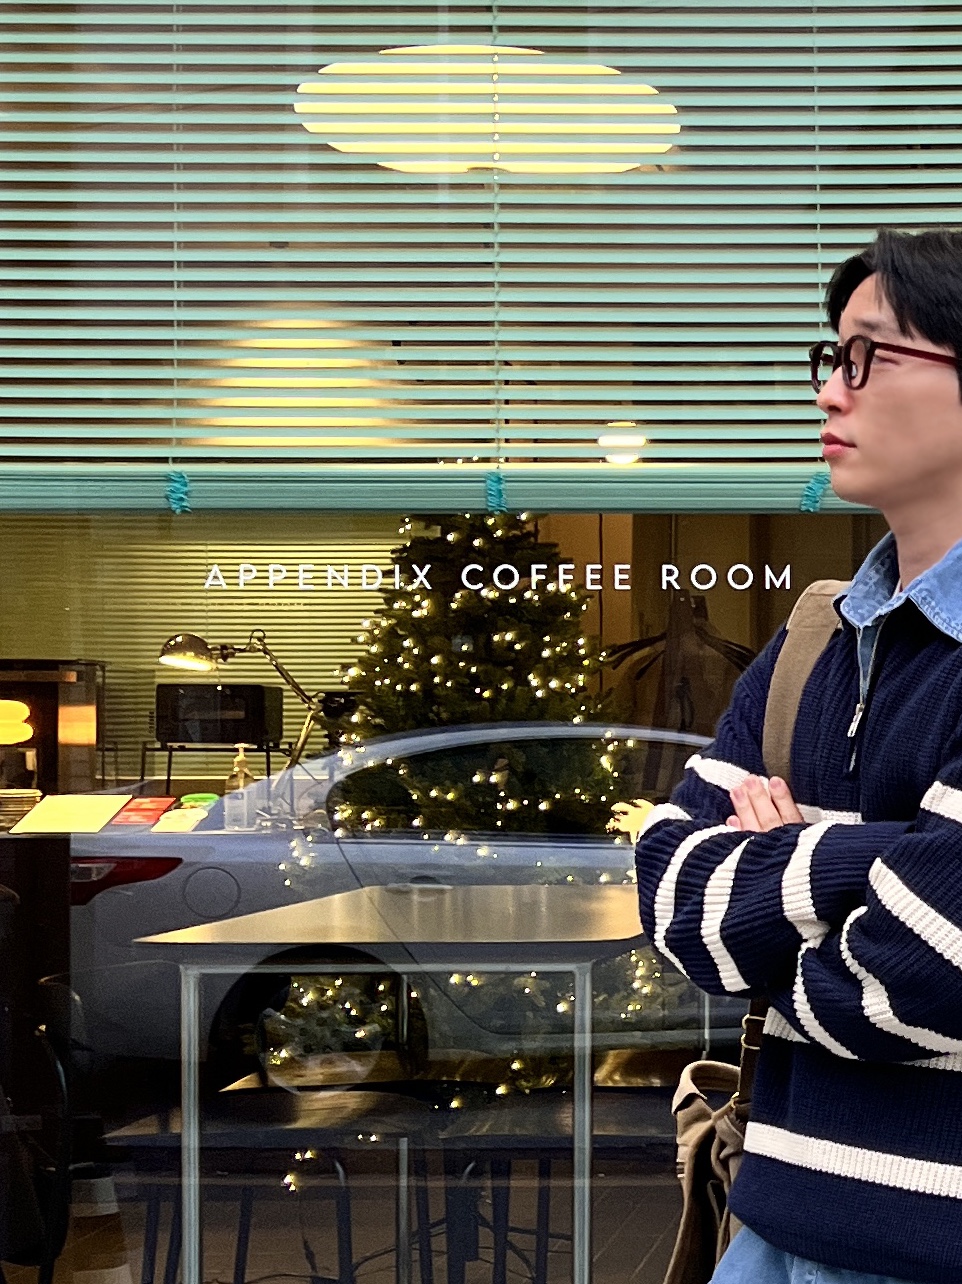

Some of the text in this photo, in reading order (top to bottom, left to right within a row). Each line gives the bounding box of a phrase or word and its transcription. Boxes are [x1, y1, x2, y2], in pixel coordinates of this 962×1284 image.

[204, 563, 791, 590] APPENDIX COFFEE ROOM
